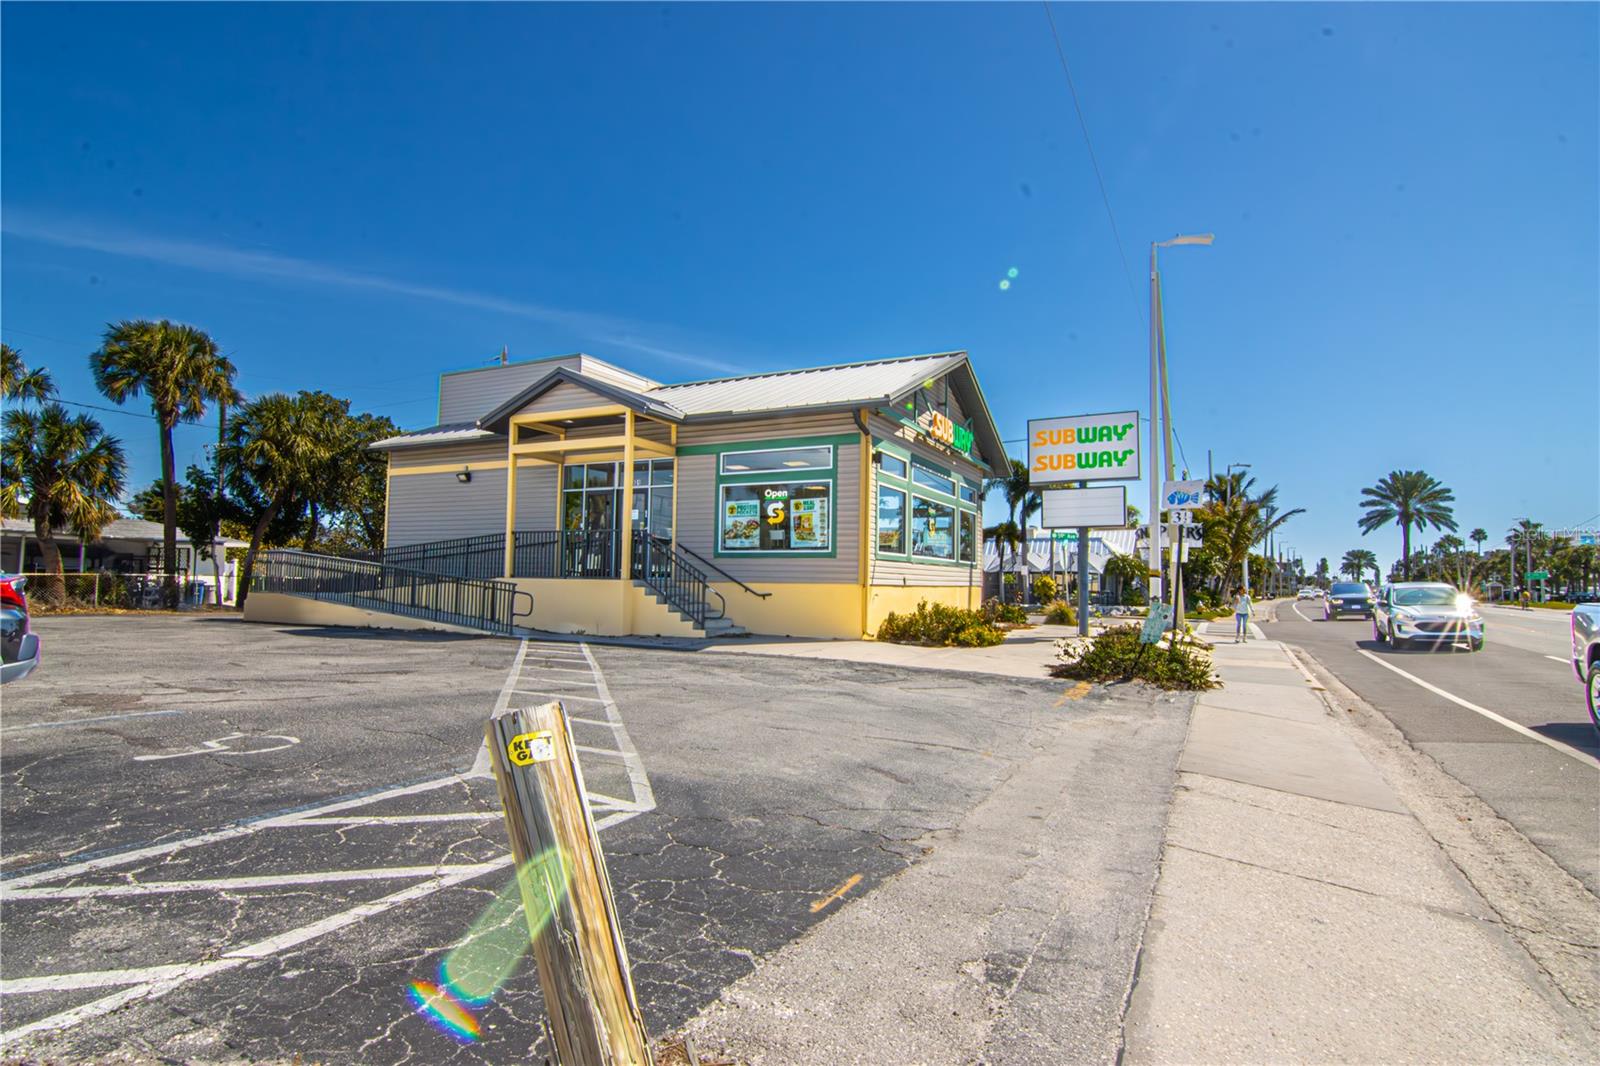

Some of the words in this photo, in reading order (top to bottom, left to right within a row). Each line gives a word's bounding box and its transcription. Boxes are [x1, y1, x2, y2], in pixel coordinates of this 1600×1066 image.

[931, 411, 974, 452] SUBWAY
[1032, 423, 1135, 448] SUBWAY
[1032, 449, 1135, 472] SUBWAY
[764, 489, 788, 499] Open
[513, 736, 552, 751] KET
